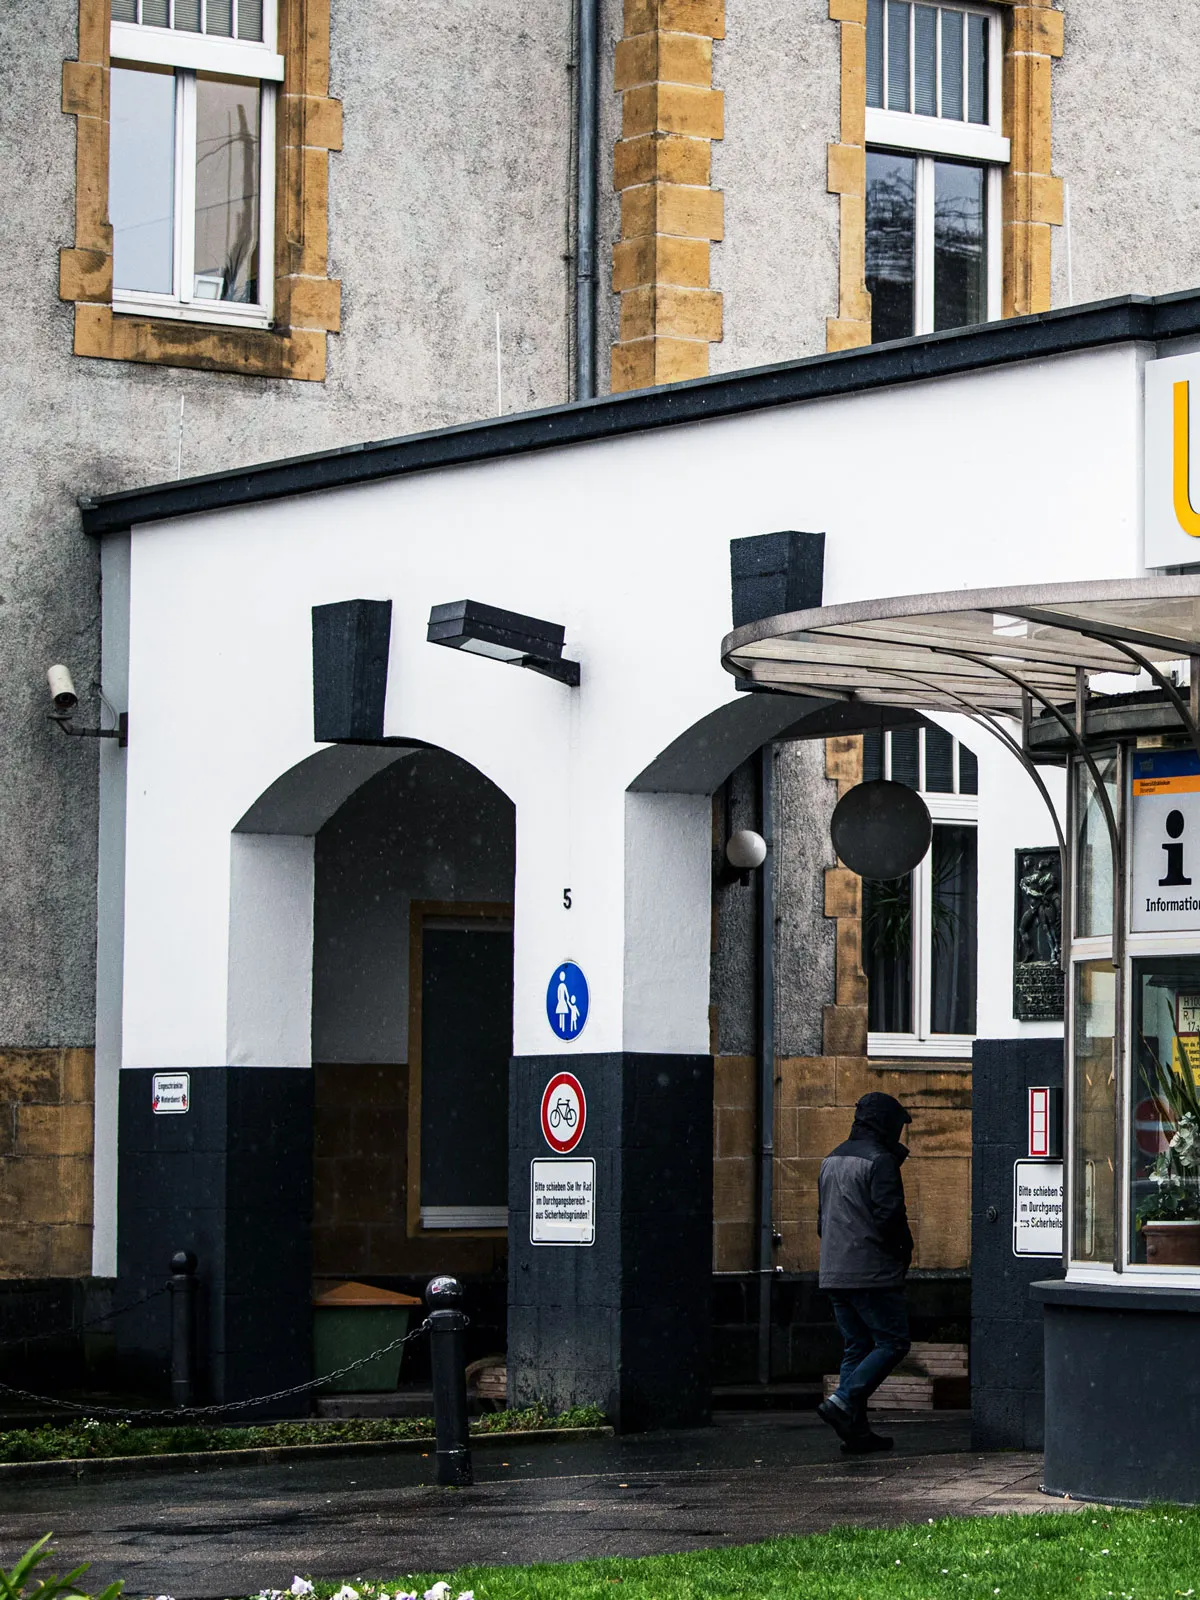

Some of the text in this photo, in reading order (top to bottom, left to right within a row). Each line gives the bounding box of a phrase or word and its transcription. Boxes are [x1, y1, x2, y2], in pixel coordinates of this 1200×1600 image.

[563, 888, 572, 910] 5
[534, 1181, 545, 1192] Bitte
[546, 1181, 566, 1192] schieben
[566, 1181, 574, 1192] Sie
[583, 1181, 592, 1192] Rad
[1018, 1185, 1031, 1197] Bitte
[1032, 1185, 1058, 1197] schieben
[535, 1195, 542, 1206] im
[542, 1195, 586, 1208] Durchgangsbereich
[1020, 1201, 1063, 1215] im Durchgangs
[535, 1209, 590, 1222] aus Sicherheitsgründen!
[1030, 1217, 1063, 1228] Sicherheits
